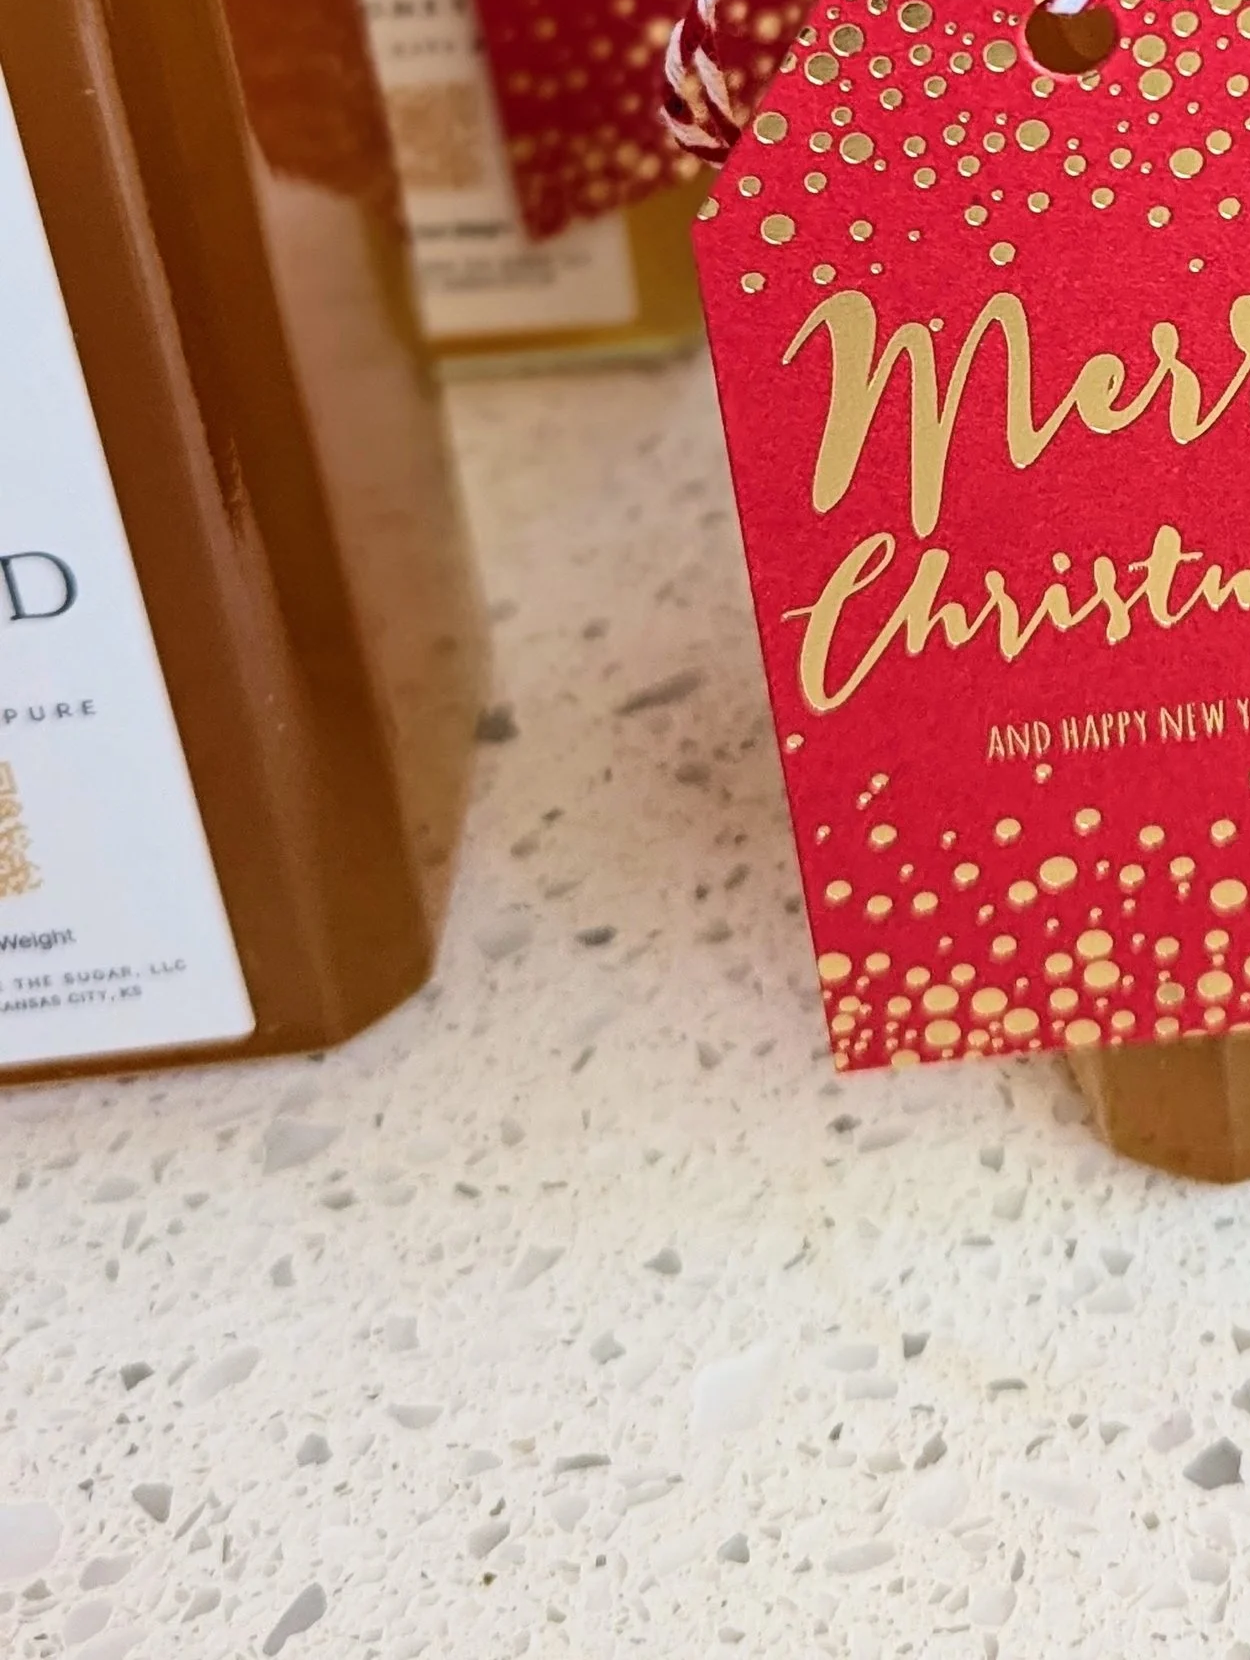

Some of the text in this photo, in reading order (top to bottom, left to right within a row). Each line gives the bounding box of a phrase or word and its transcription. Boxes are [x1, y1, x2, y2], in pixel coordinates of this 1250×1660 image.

[4, 698, 99, 725] PURE
[985, 720, 1051, 761] AND
[1060, 710, 1146, 755] HAPPY
[1159, 700, 1225, 744] NEW
[13, 972, 53, 991] THE
[149, 958, 188, 976] LLC
[0, 993, 62, 1013] ANSAS
[118, 983, 143, 998] KS
